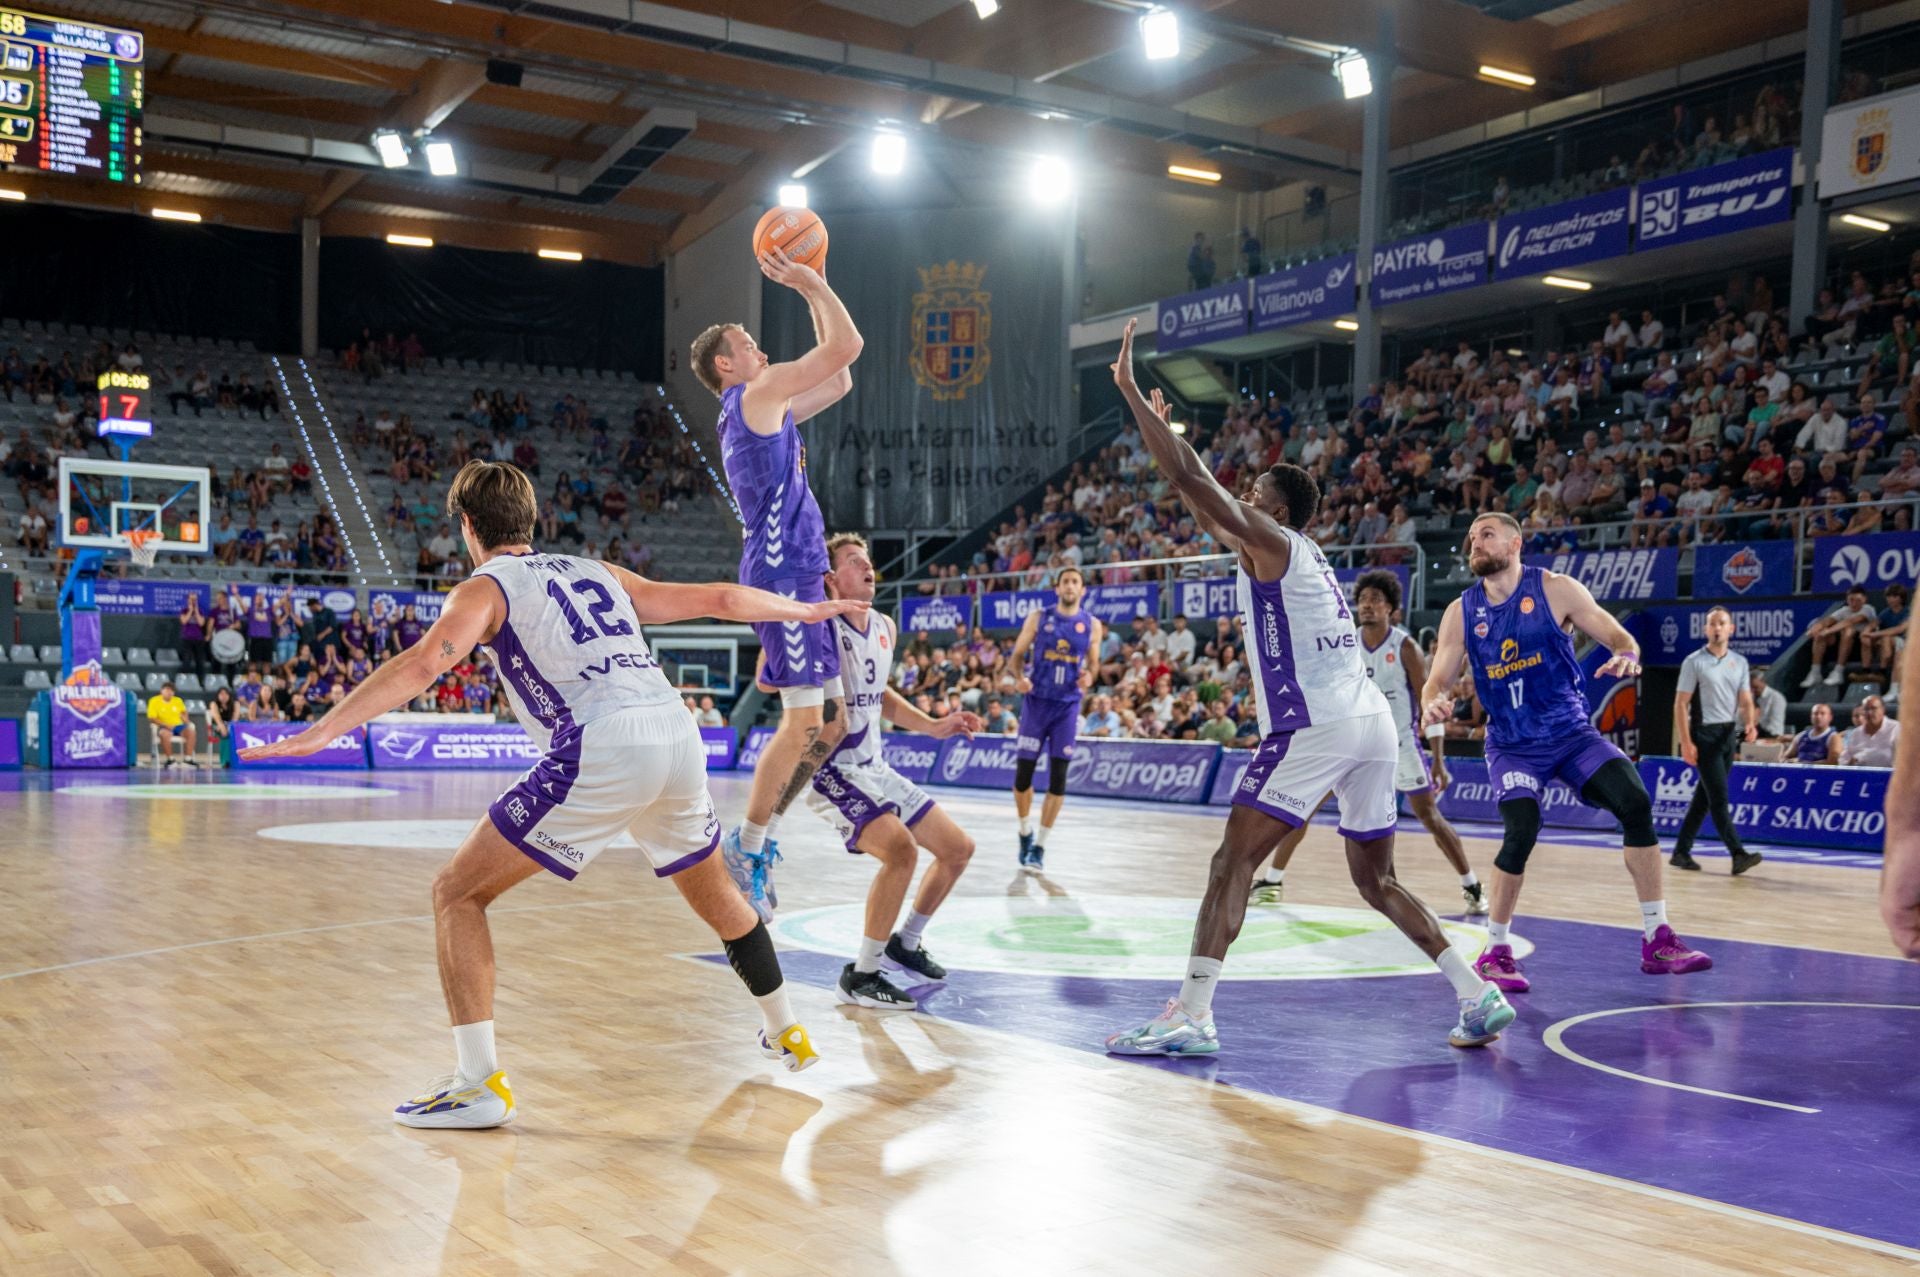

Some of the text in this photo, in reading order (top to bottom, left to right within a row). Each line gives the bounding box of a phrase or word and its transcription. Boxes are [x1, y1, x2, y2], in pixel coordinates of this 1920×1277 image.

[51, 33, 112, 53] VALLADOLID
[1687, 168, 1784, 200] Transportes
[1682, 186, 1787, 225] BUJ
[1525, 207, 1627, 242] NEUMÁTICOS
[1518, 231, 1597, 260] PALENCIA
[1180, 293, 1244, 323] VAYMA
[1258, 287, 1325, 315] Villanova
[839, 422, 1059, 455] Ayuntamiento
[856, 459, 1041, 489] de Palencia
[268, 586, 322, 598] Horalizas
[547, 578, 634, 645] 12
[1315, 634, 1359, 651] IVE
[864, 658, 876, 685] 3
[1487, 652, 1543, 680] agropal
[60, 685, 117, 700] PALENCIA
[1508, 677, 1524, 710] 17
[1101, 748, 1132, 761] super
[1092, 757, 1208, 788] agropal
[1242, 776, 1260, 791] CBC
[1265, 788, 1306, 809] SYNERGIA
[1743, 776, 1870, 798] HOTEL
[508, 797, 530, 823] CBC
[849, 800, 868, 817] CBC
[1771, 806, 1885, 835] SANCHO
[536, 831, 585, 862] SYNERGIA
